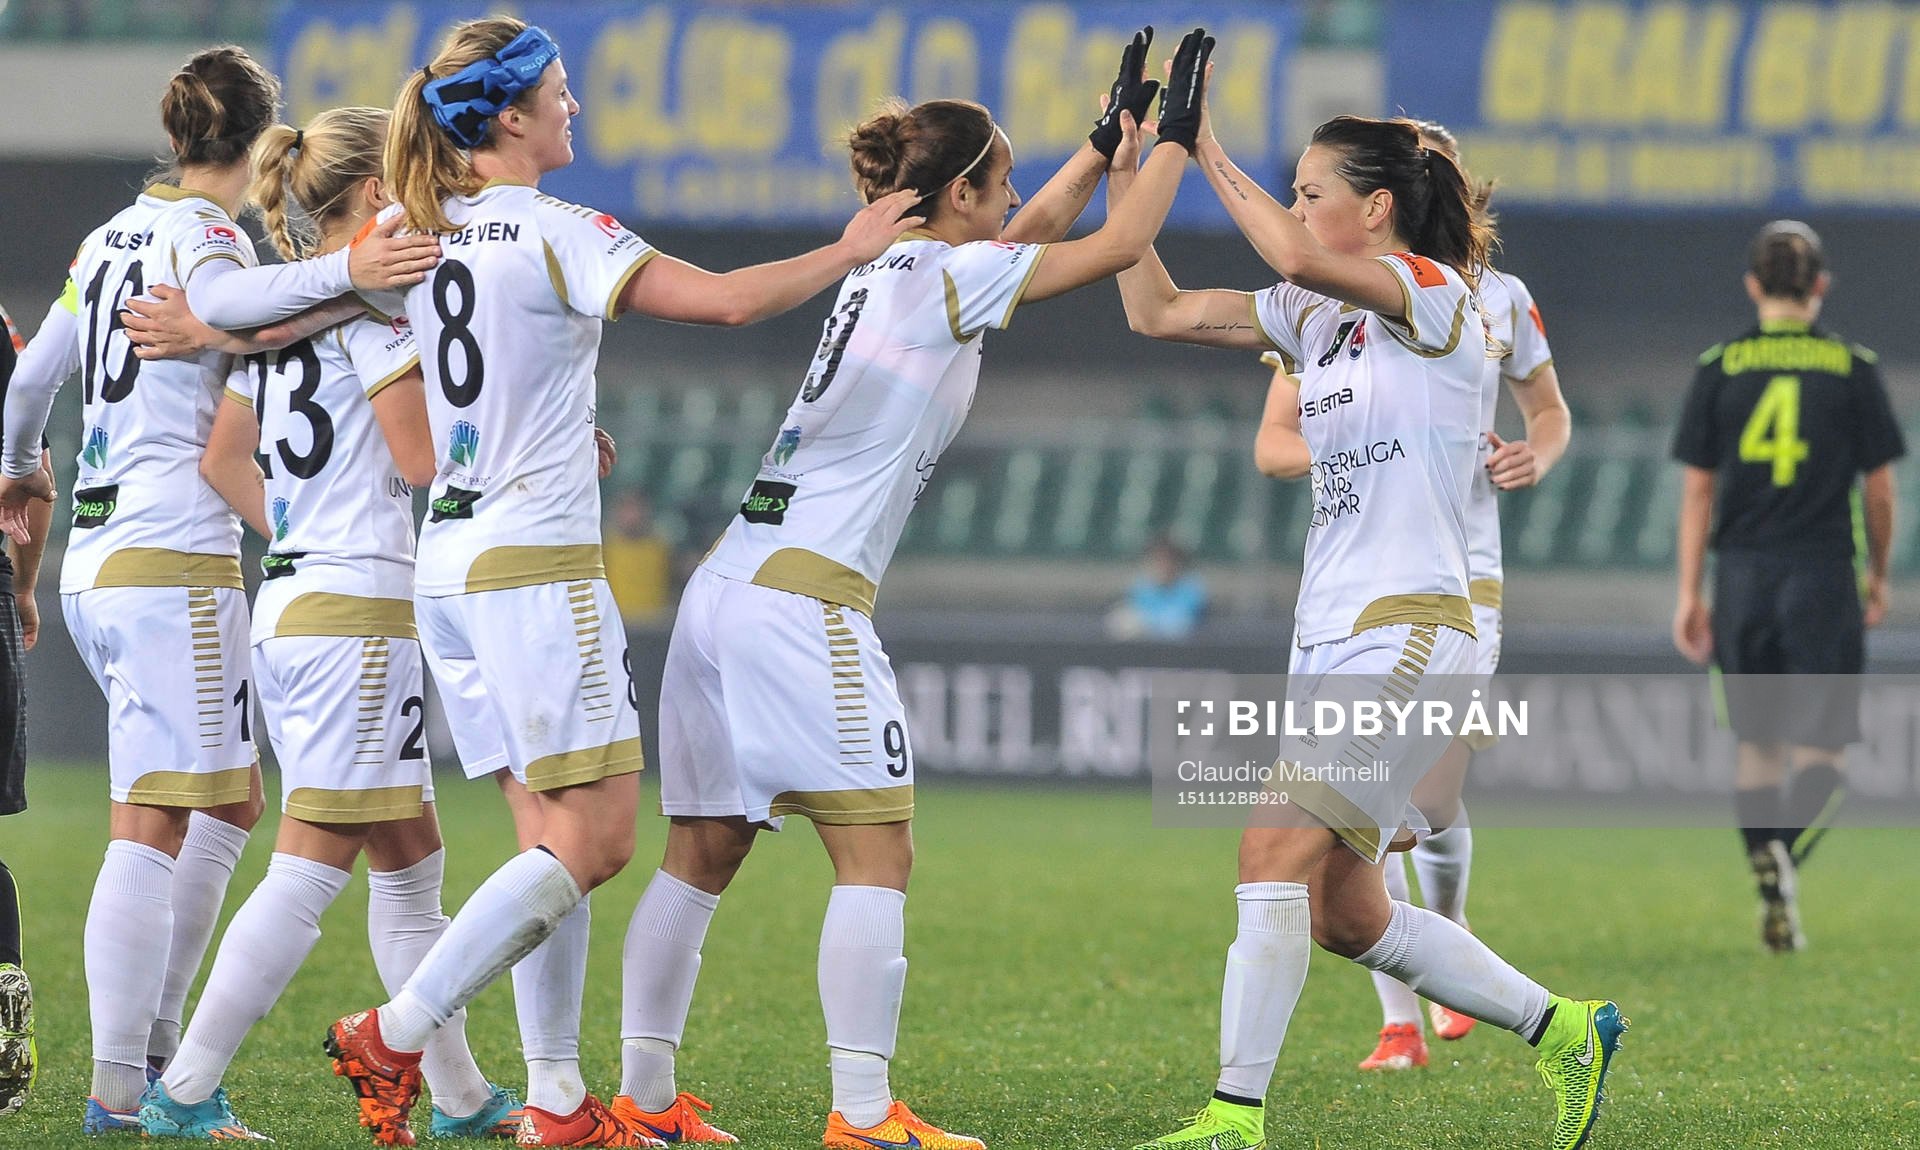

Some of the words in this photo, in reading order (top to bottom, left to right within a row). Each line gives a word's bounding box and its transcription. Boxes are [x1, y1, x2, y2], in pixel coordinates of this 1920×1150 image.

[477, 221, 520, 243] VEN
[385, 330, 414, 352] SVENSK
[433, 258, 484, 409] 8
[1739, 376, 1810, 488] 4
[233, 679, 251, 742] 1
[399, 695, 424, 761] 2
[883, 720, 908, 778] 9
